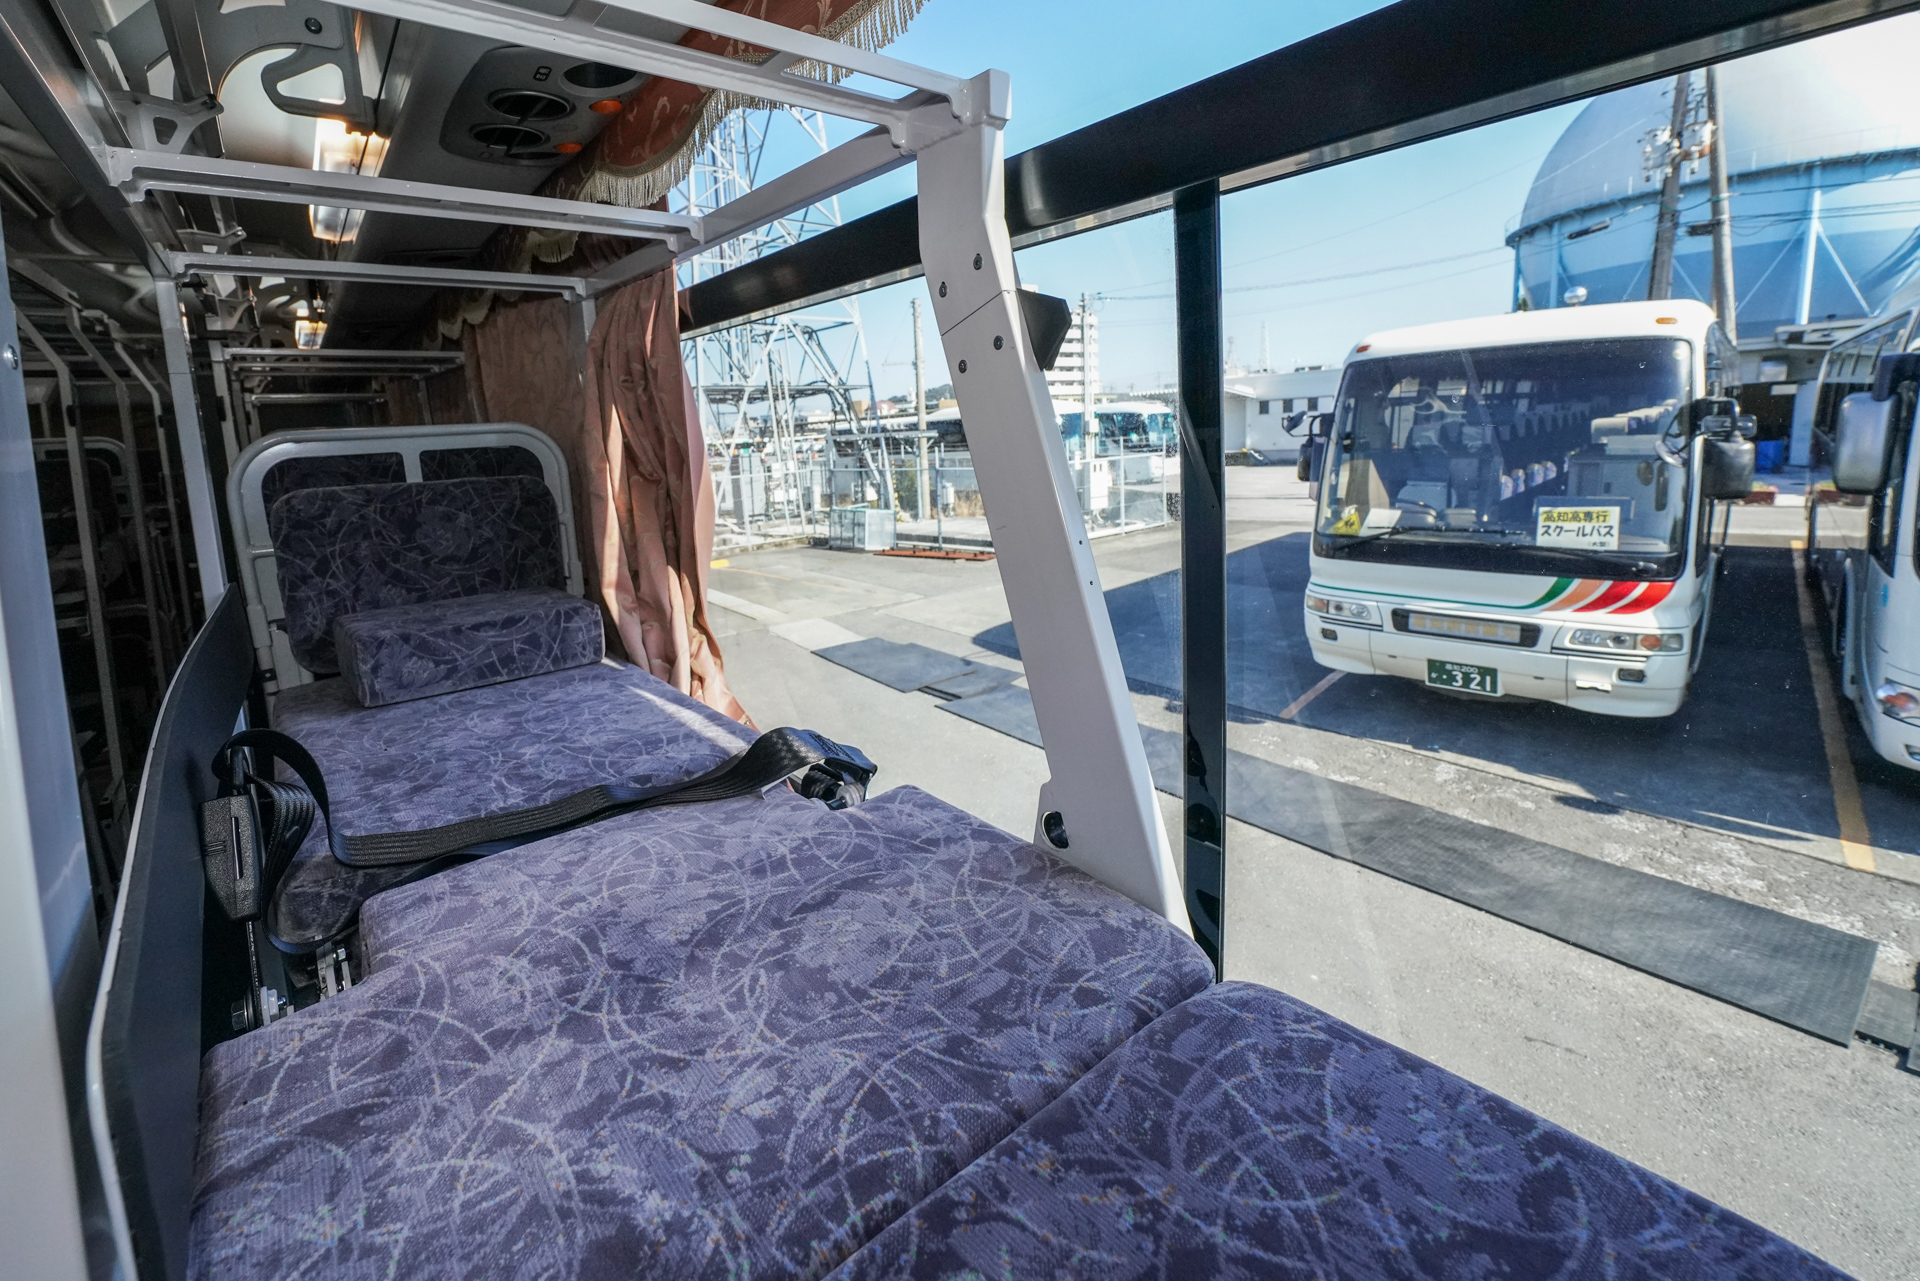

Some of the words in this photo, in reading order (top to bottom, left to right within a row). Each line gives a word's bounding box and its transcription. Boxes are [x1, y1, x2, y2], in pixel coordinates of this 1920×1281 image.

[1541, 524, 1614, 538] スクールバス
